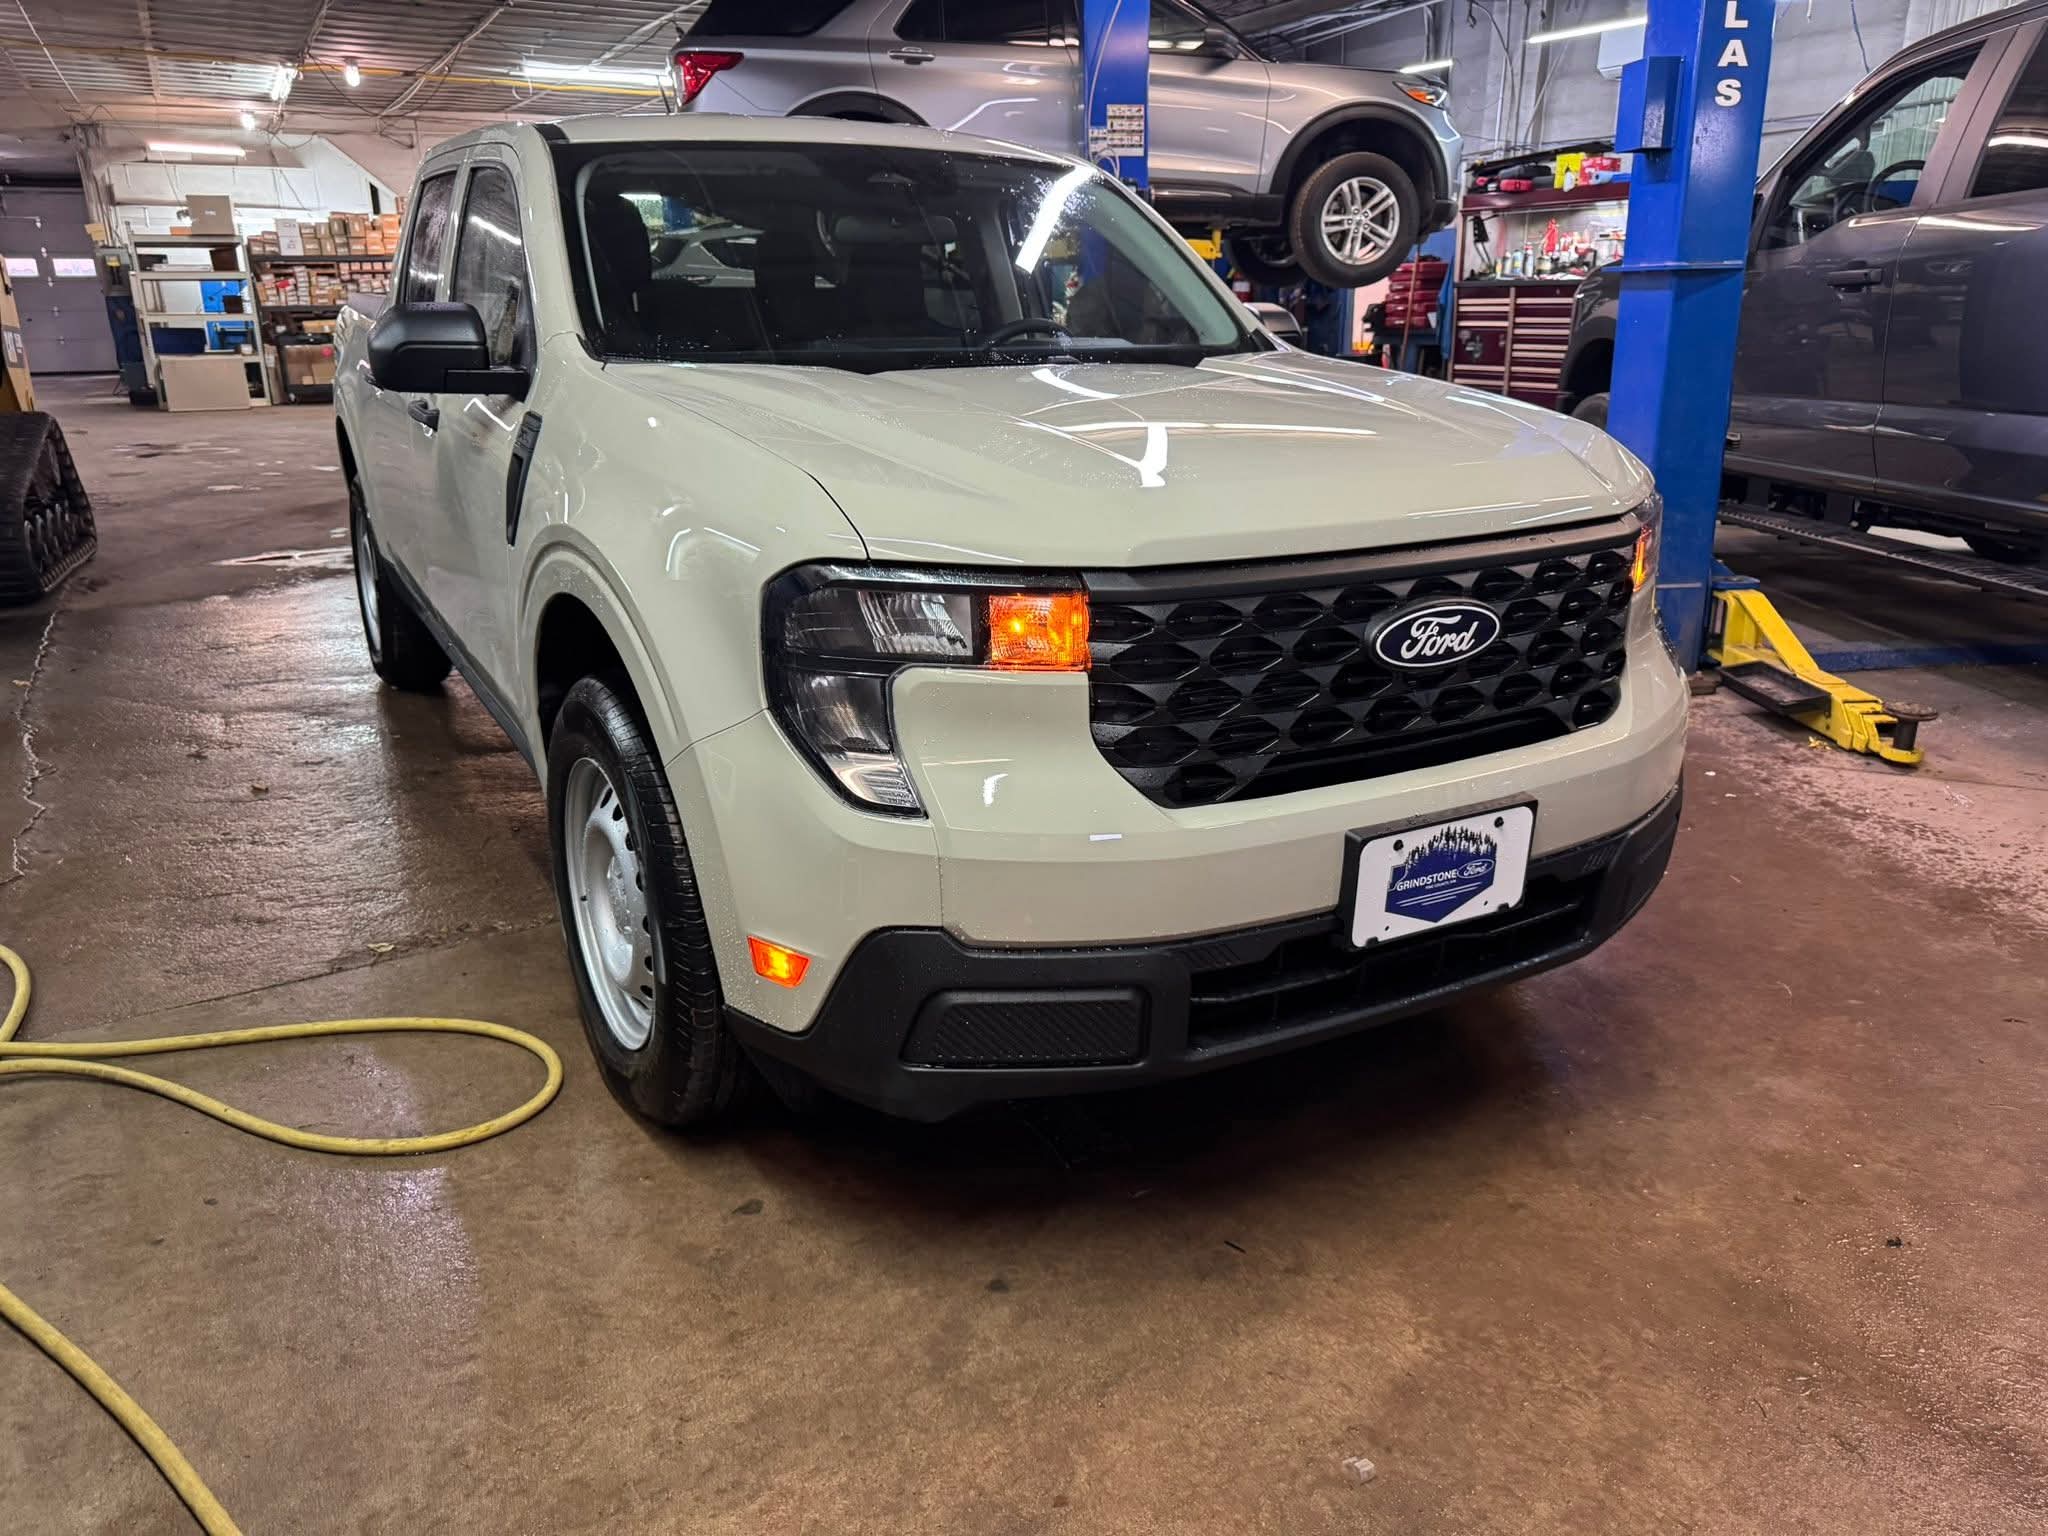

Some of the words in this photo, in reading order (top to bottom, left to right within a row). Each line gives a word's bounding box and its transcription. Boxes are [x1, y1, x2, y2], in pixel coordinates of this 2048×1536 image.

[1401, 615, 1479, 658] Ford
[1396, 868, 1457, 891] GRINDSTONE
[1463, 862, 1488, 876] Ford
